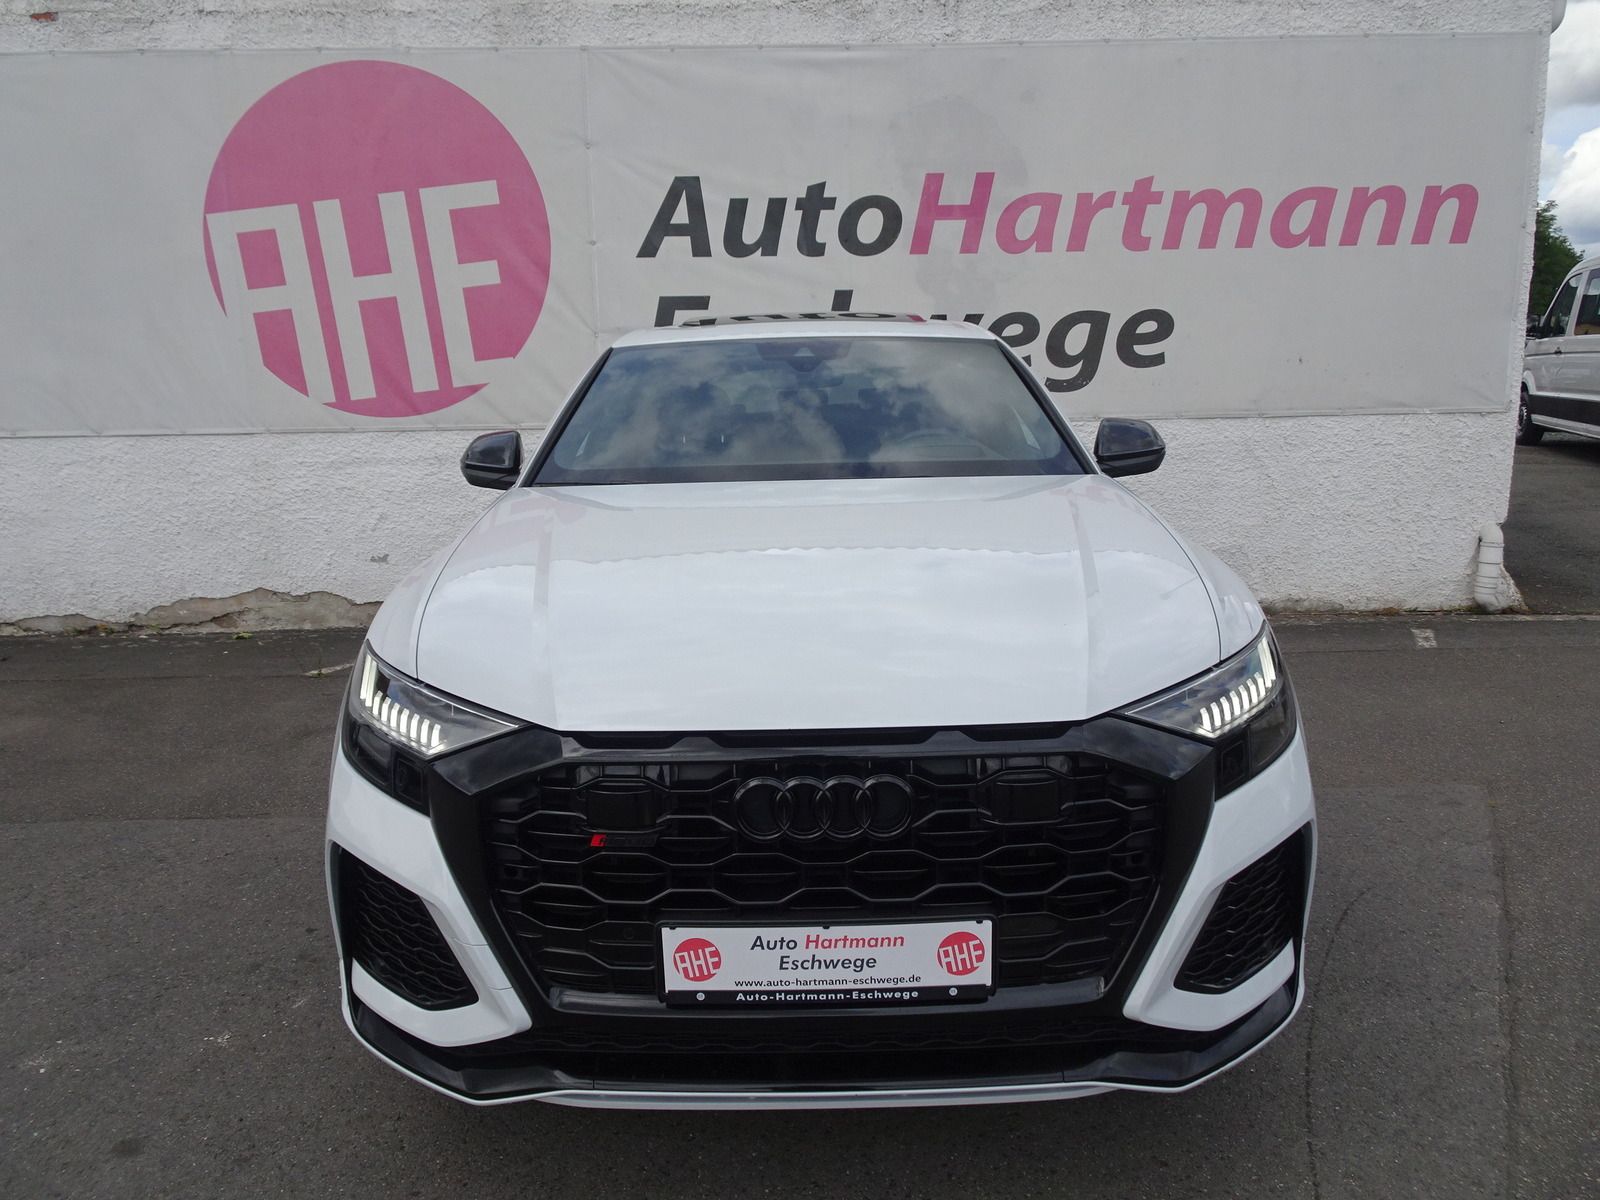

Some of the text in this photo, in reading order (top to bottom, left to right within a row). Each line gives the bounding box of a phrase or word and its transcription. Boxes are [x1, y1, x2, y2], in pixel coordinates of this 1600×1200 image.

[205, 179, 516, 404] AHE
[750, 934, 905, 951] Auto Hartmann
[675, 946, 721, 978] AHE
[779, 954, 877, 973] Eschwege
[940, 940, 983, 973] AHE
[734, 974, 922, 988] www.auto-hartmann-eschwege.de
[736, 990, 919, 1001] Auto-Hartmann-Eschwege
